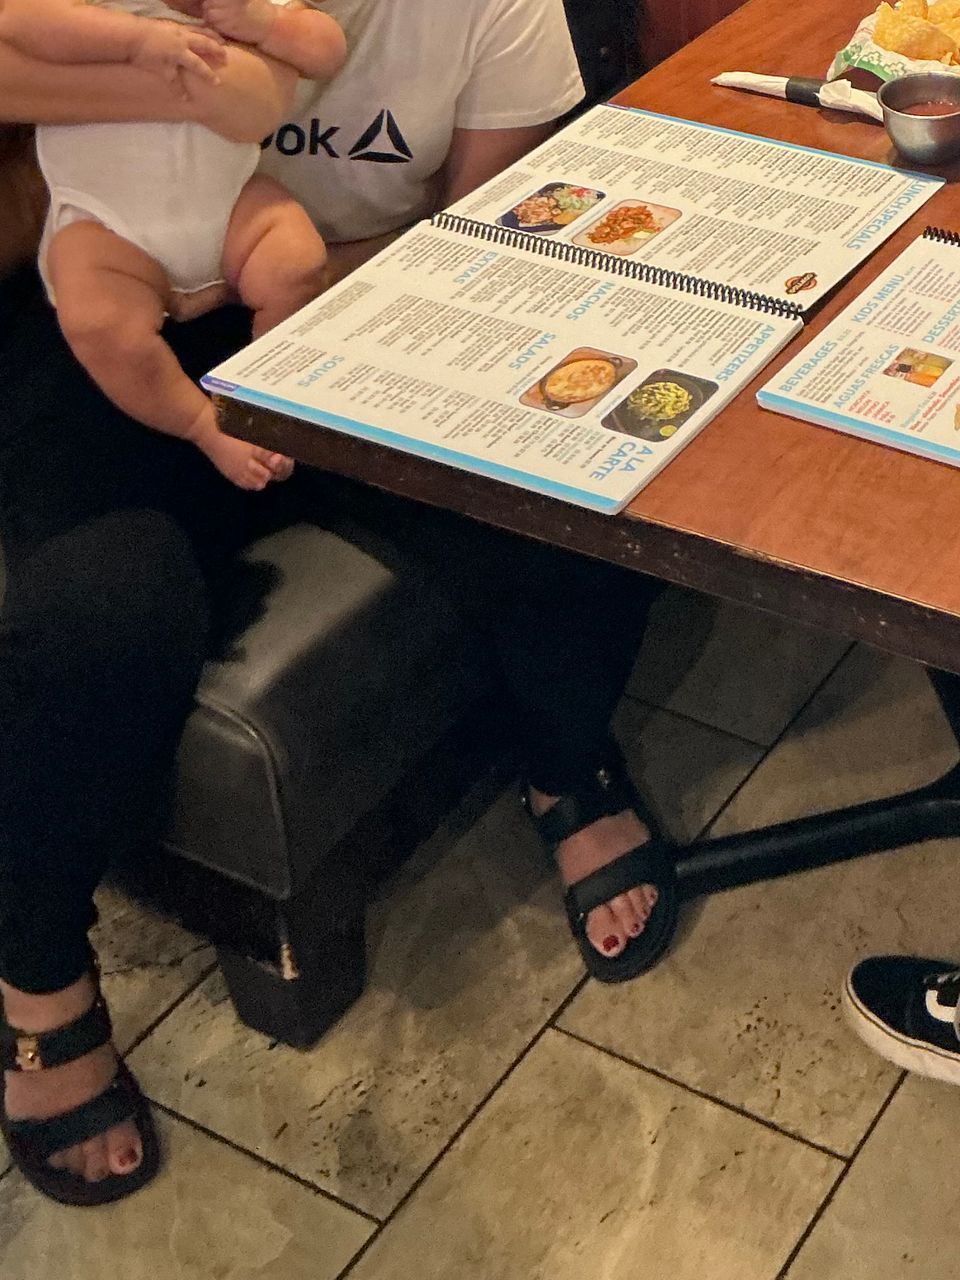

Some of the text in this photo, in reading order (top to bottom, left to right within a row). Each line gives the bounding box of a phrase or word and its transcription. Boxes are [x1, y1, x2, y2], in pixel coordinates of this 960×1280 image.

[847, 208, 898, 249] SPECIALS
[453, 251, 498, 284] EXTRAS
[566, 281, 616, 320] NACHOS
[851, 274, 905, 322] KIDS MENU
[297, 354, 345, 387] SOUPS
[508, 332, 556, 370] SALADS
[716, 325, 776, 381] APPETIZERS
[778, 340, 838, 392] BEVERAGES
[834, 375, 867, 408] AGUAS
[861, 343, 900, 380] FRESCAS
[589, 441, 637, 481] CARTE
[619, 445, 654, 472] A LA
